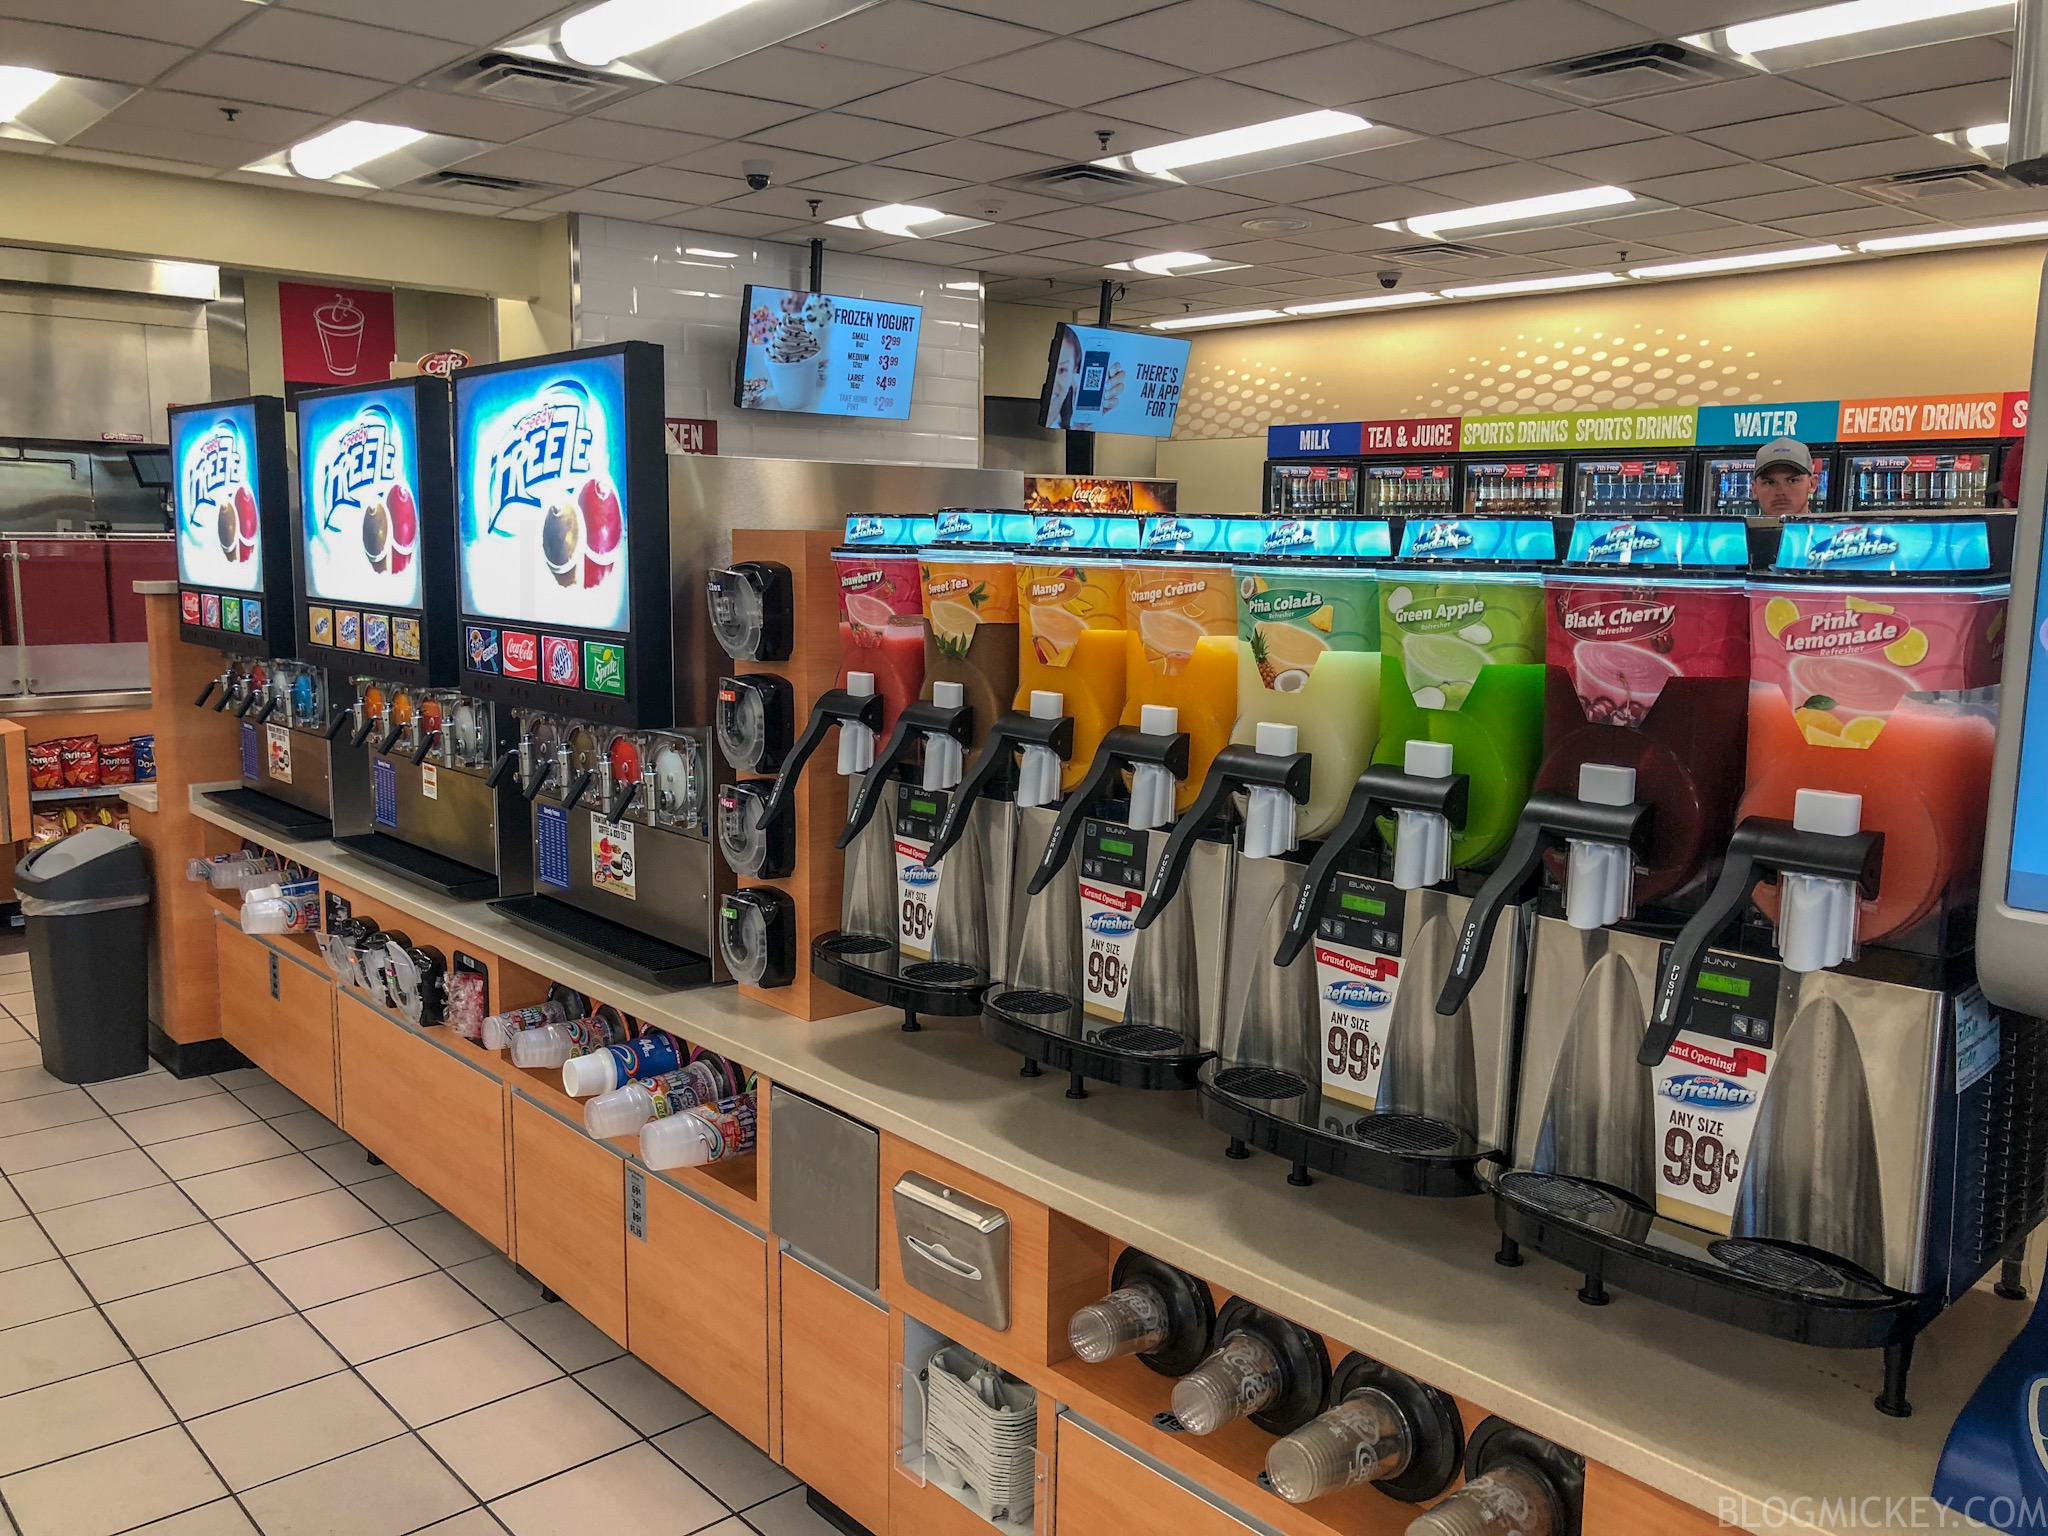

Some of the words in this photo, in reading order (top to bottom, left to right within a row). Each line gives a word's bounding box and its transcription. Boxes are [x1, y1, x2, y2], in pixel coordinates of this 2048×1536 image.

[834, 308, 874, 327] FROZEN
[876, 313, 915, 332] YOGURT
[852, 332, 869, 341] SMALL
[848, 352, 869, 361] MEDIUM
[848, 374, 864, 382] LARGE
[1136, 363, 1178, 383] THERE'S
[1140, 383, 1156, 398] AN
[1157, 384, 1179, 400] APP
[1145, 400, 1166, 418] FOR
[1842, 404, 1918, 434] ENERGY
[1921, 402, 1997, 431] DRINKS
[1463, 422, 1515, 445] SPORTS
[1518, 420, 1568, 444] DRINKS
[1576, 417, 1632, 442] SPORTS
[1636, 414, 1693, 440] DRINKS
[1733, 410, 1798, 437] WATER
[1299, 428, 1330, 451] MILK
[1368, 426, 1392, 448] TEA
[1396, 426, 1408, 448] &
[1412, 423, 1453, 447] JUICE
[1876, 459, 1888, 467] 7th
[1276, 524, 1298, 537] Iced
[1426, 524, 1451, 539] Icd
[1606, 524, 1637, 543] Iced
[1830, 528, 1870, 548] Iced
[1588, 536, 1660, 562] Specialties
[1808, 541, 1898, 568] Specialties
[928, 581, 950, 595] Sweet
[950, 578, 970, 590] Tea
[1032, 581, 1066, 598] Mango
[1132, 588, 1162, 603] Orange
[1164, 580, 1206, 597] Crème
[1249, 596, 1272, 614] Piña
[1273, 591, 1323, 612] Colada
[1396, 606, 1433, 624] Green
[1434, 598, 1485, 623] Apple
[1268, 610, 1295, 620] Refresher
[1564, 610, 1606, 629] Black
[1609, 604, 1676, 626] Cherry
[1810, 608, 1862, 633] Pink
[1420, 622, 1451, 631] Refresher
[1596, 626, 1634, 636] Refresher
[1786, 621, 1898, 652] Lemonade
[482, 643, 498, 662] GRAPE
[506, 638, 534, 661] Coca-Cola
[554, 645, 568, 666] Wild
[1820, 645, 1865, 658] Refresher
[552, 651, 572, 680] Cherry
[596, 659, 618, 682] Sprite
[61, 750, 91, 760] Doritos
[100, 757, 130, 766] Doritos
[856, 788, 866, 808] PUSH
[945, 803, 956, 824] PUSH
[1050, 826, 1060, 848] PUSH
[1106, 826, 1126, 836] BUNN
[900, 866, 939, 881] Refreshers
[1158, 854, 1169, 878] PUSH
[904, 888, 914, 899] ANY
[916, 892, 927, 902] SIZE
[1348, 880, 1376, 892] BUNN
[1084, 888, 1100, 901] Grand
[1100, 893, 1128, 909] Opening!
[1299, 884, 1311, 911] PUSH
[902, 900, 933, 940] 99¢
[1090, 939, 1104, 950] ANY
[1106, 943, 1120, 956] SIZE
[1462, 923, 1476, 952] PUSH
[1321, 950, 1346, 968] Grand
[1348, 958, 1378, 978] Opening!
[1702, 956, 1736, 969] BUNN
[1088, 952, 1128, 998] 99¢
[1664, 965, 1680, 997] PUSH
[1322, 984, 1392, 1005] Refreshers
[1330, 1011, 1348, 1028] ANY
[1350, 1016, 1370, 1033] SIZE
[1326, 1026, 1381, 1082] 99¢
[1669, 1044, 1689, 1058] and
[1690, 1050, 1737, 1073] Opening!
[1658, 1078, 1757, 1104] Refreshers
[1669, 1109, 1694, 1128] ANY
[1697, 1116, 1724, 1138] SIZE
[1662, 1127, 1740, 1196] 99¢
